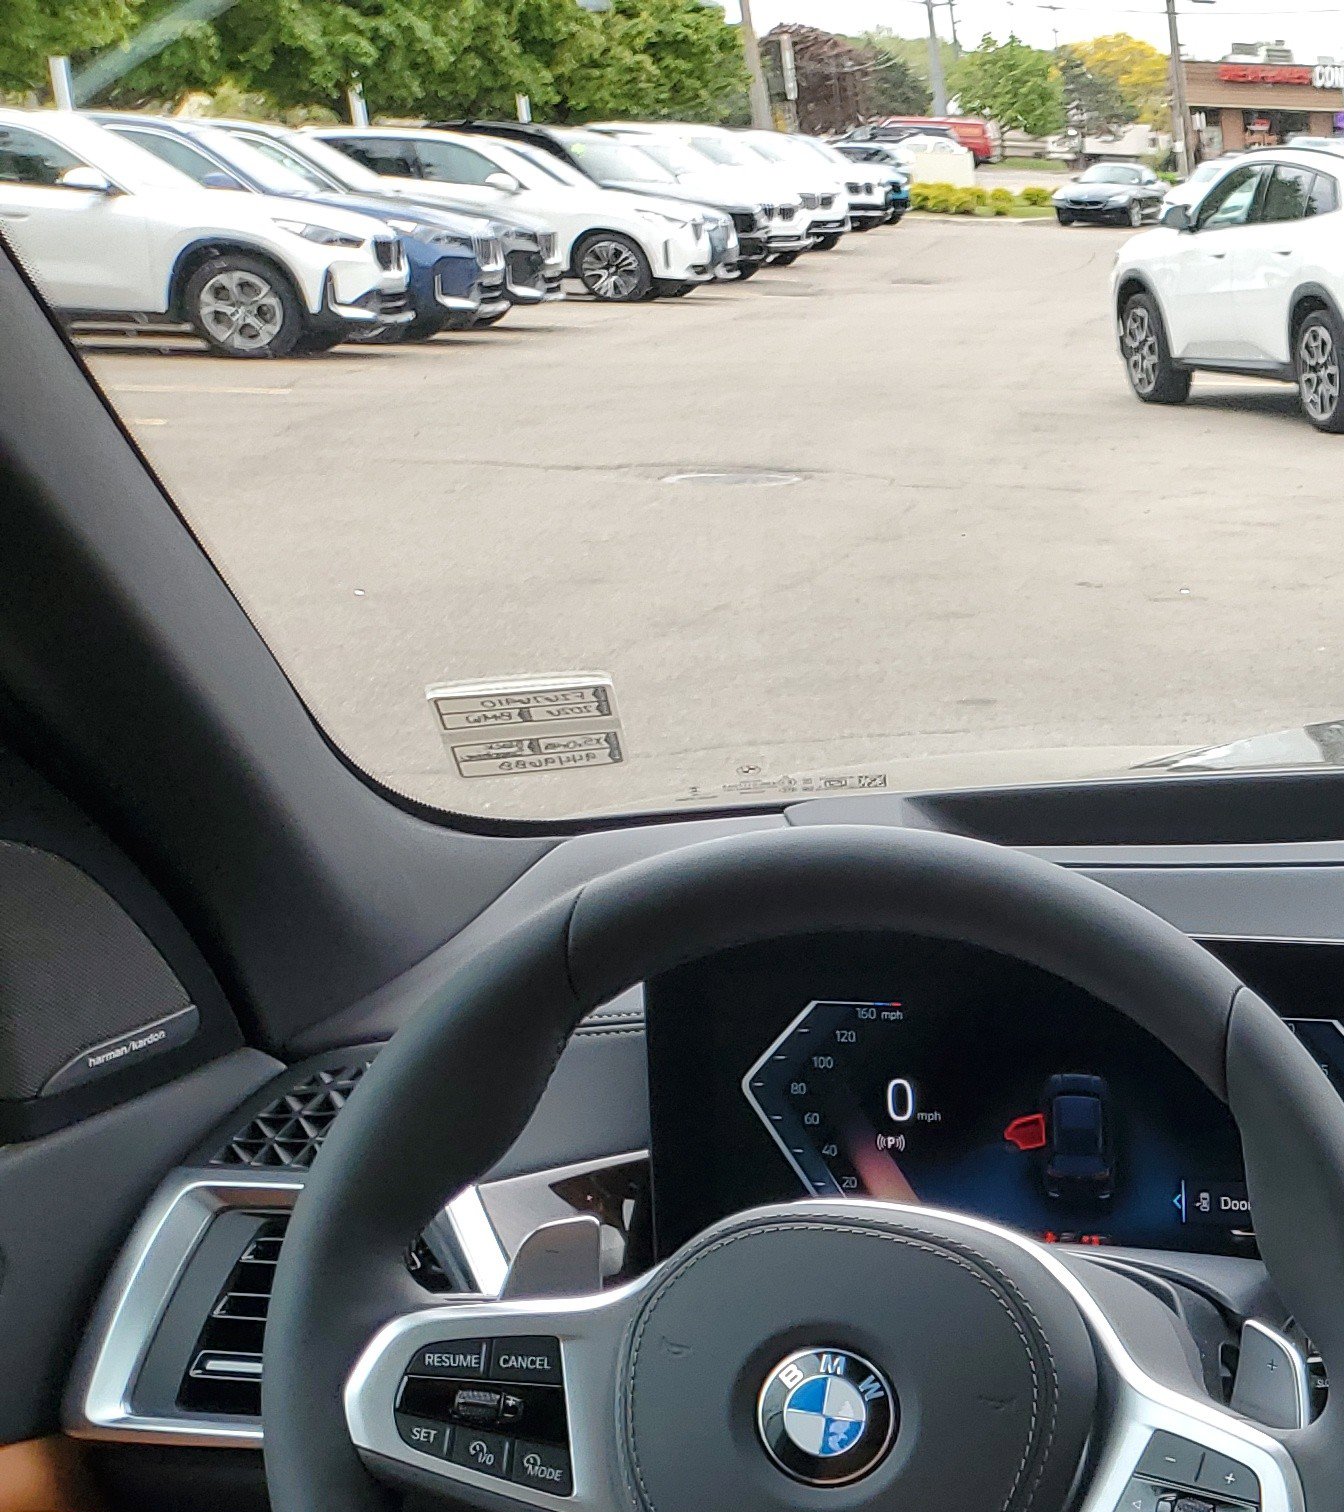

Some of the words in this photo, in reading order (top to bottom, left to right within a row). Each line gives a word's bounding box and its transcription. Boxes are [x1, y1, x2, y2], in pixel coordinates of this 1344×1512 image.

[855, 1008, 876, 1019] 160
[835, 1030, 856, 1042] 120
[88, 1029, 166, 1069] harman/kardon
[812, 1056, 834, 1068] 100
[790, 1082, 806, 1095] 80
[887, 1078, 914, 1121] 0
[917, 1111, 941, 1122] mph
[804, 1112, 820, 1125] 60
[821, 1144, 838, 1156] 40
[842, 1177, 858, 1189] 20
[424, 1353, 480, 1368] RESUME
[499, 1355, 551, 1370] CANCEL
[778, 1353, 885, 1402] BMW
[411, 1427, 437, 1443] SET
[527, 1463, 562, 1481] MODE
